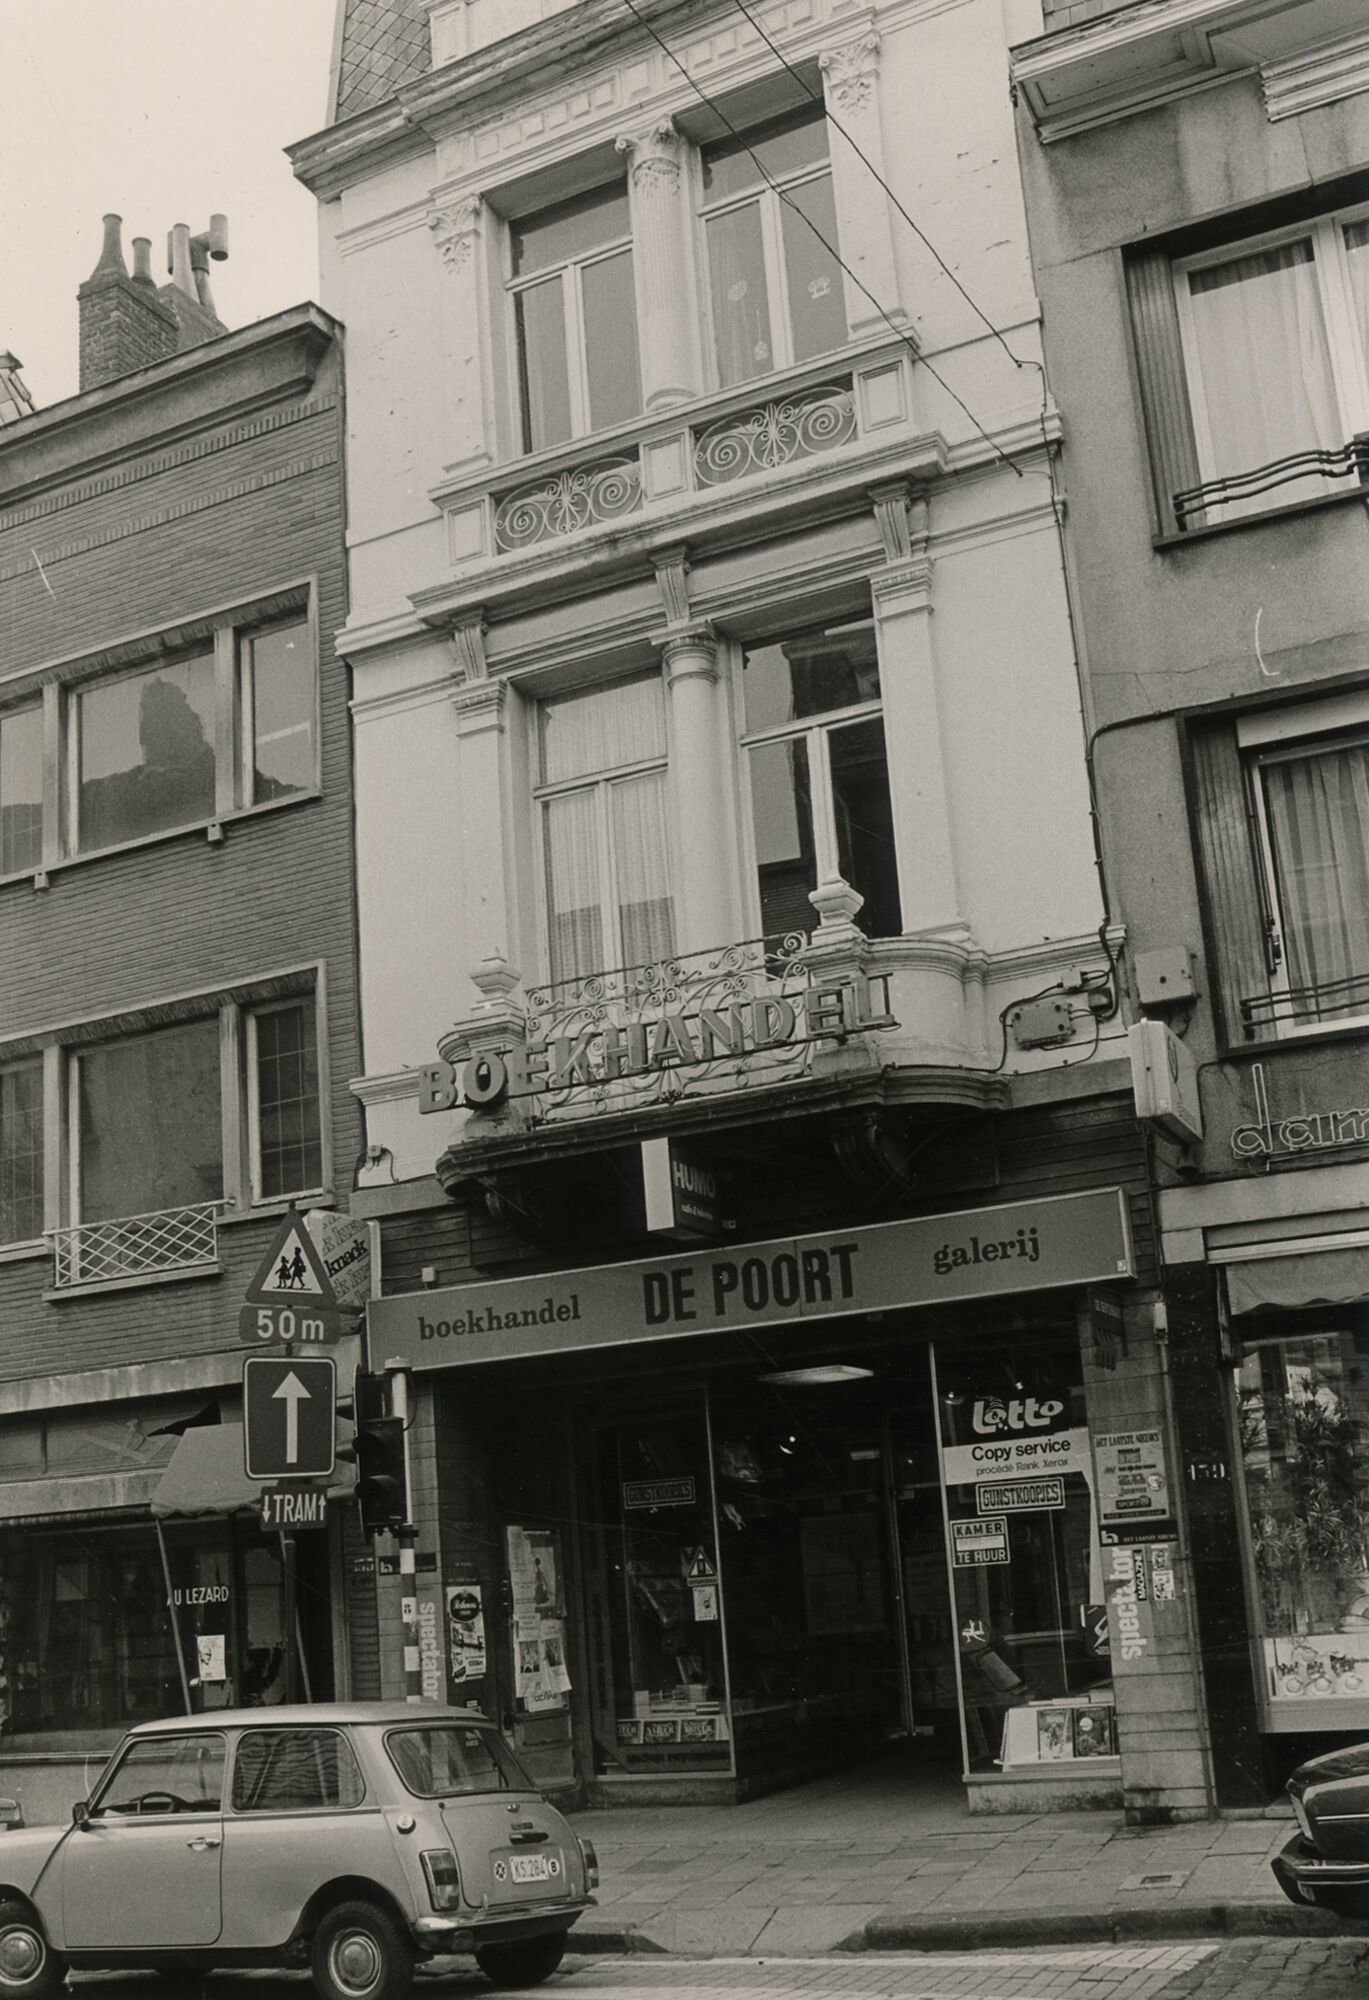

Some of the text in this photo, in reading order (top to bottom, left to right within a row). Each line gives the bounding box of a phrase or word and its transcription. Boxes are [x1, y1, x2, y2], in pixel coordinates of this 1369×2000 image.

[418, 971, 894, 1114] BOEKHANDEL
[673, 1160, 716, 1198] HUMO
[324, 1239, 368, 1278] knack
[417, 1226, 1040, 1341] boekhandel DE POORT galerij
[972, 1439, 1071, 1462] Copy service
[1016, 1460, 1041, 1472] Rank
[1043, 1458, 1070, 1469] Xerox
[273, 1493, 317, 1523] TRAM
[983, 1484, 1059, 1507] GUNSTKOOPJES
[956, 1523, 1003, 1537] KAMER
[958, 1550, 1006, 1563] TE HUUR
[186, 1586, 230, 1605] LEZARD
[419, 1602, 441, 1701] spectator
